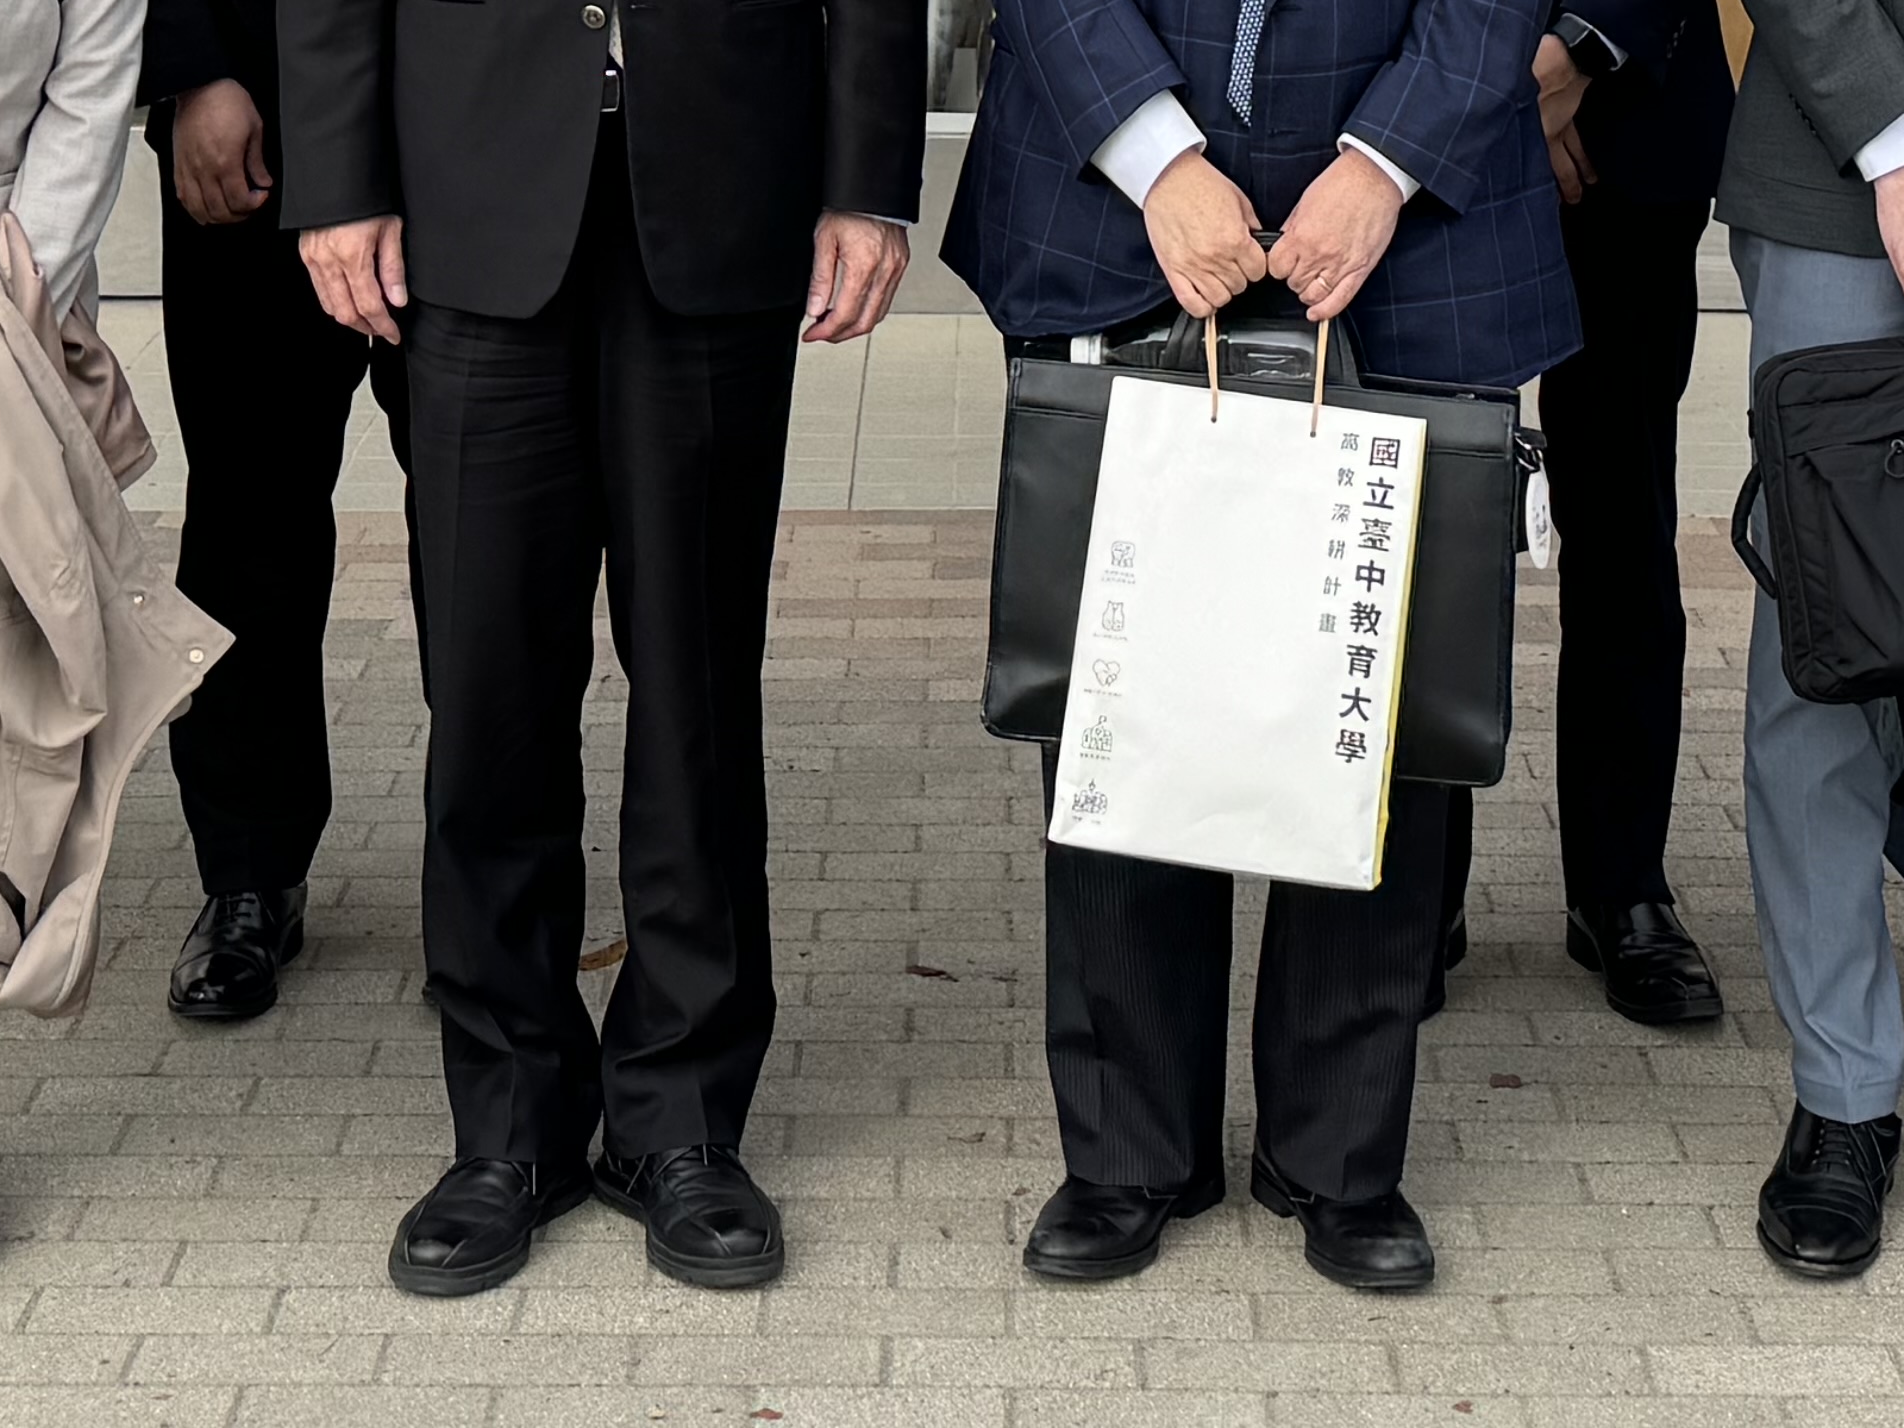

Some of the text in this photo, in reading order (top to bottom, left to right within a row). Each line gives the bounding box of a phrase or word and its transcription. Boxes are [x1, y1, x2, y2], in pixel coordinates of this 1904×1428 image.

[1335, 437, 1400, 763] 國立臺中教育大學
